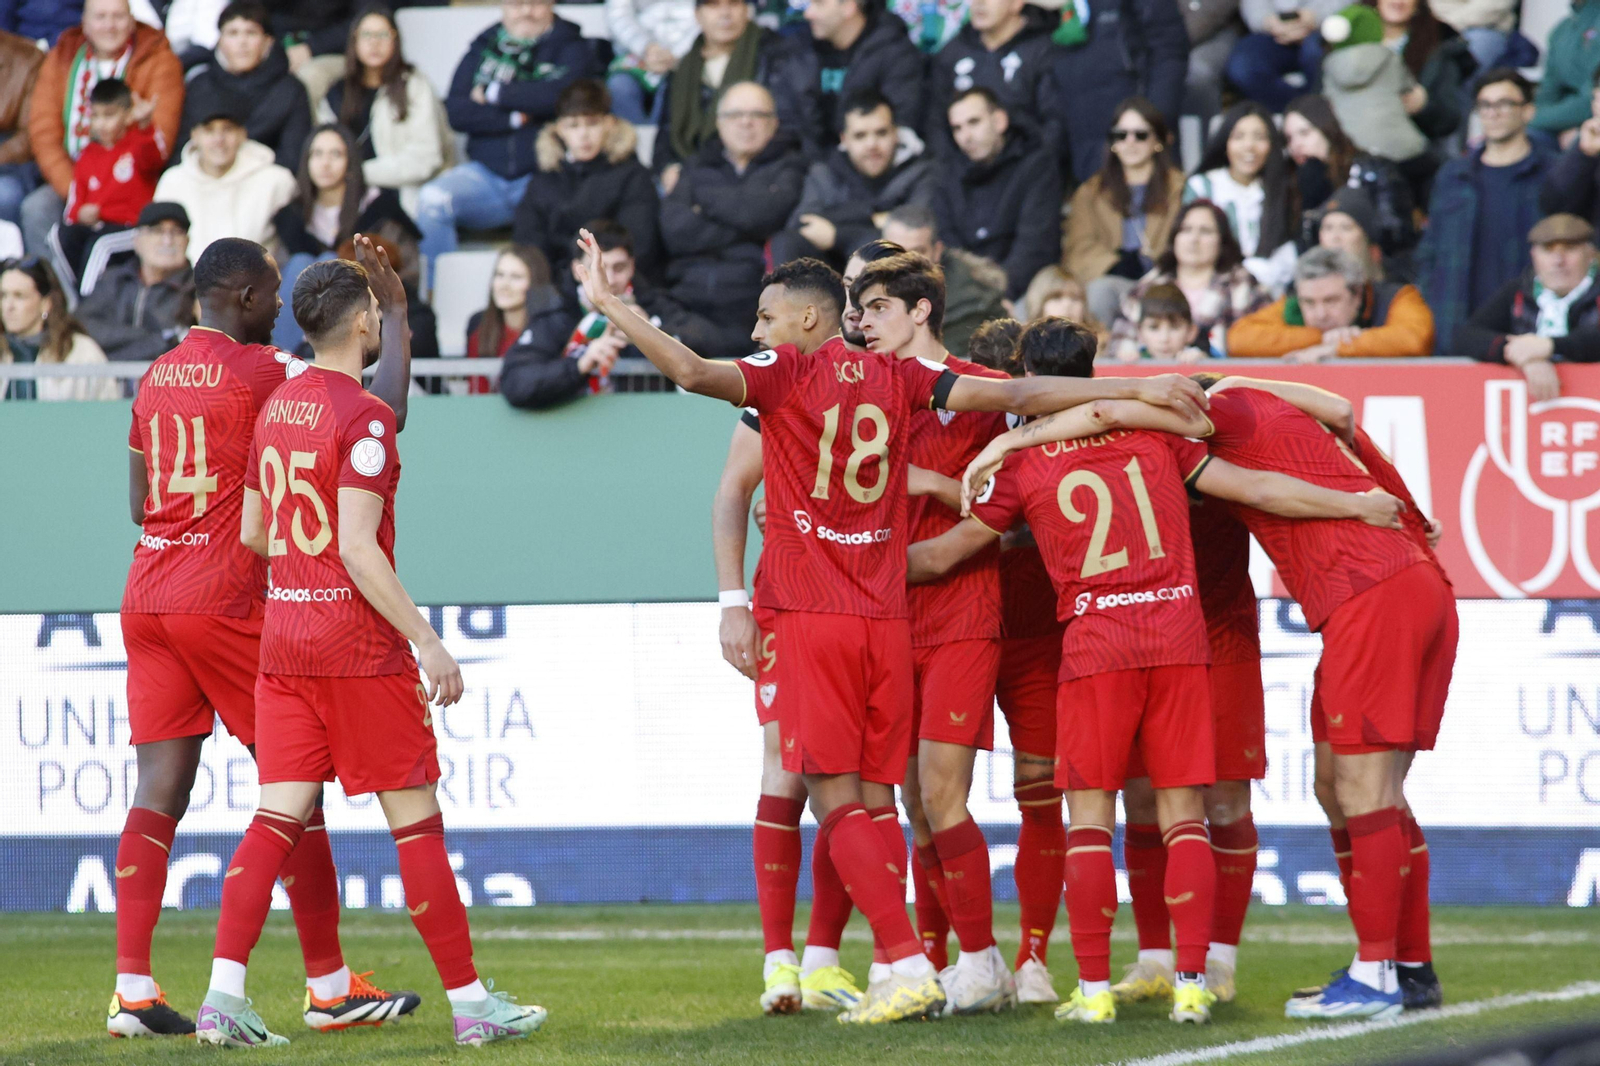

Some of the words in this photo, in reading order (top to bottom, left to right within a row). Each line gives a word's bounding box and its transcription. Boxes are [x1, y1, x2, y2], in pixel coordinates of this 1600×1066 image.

[149, 363, 223, 388] NIANZOU
[264, 399, 325, 431] JANUZAJ
[146, 411, 218, 518] 14
[260, 445, 333, 557] 25
[810, 402, 890, 504] 18
[1057, 455, 1166, 579] 21
[1096, 584, 1193, 610] socios.com
